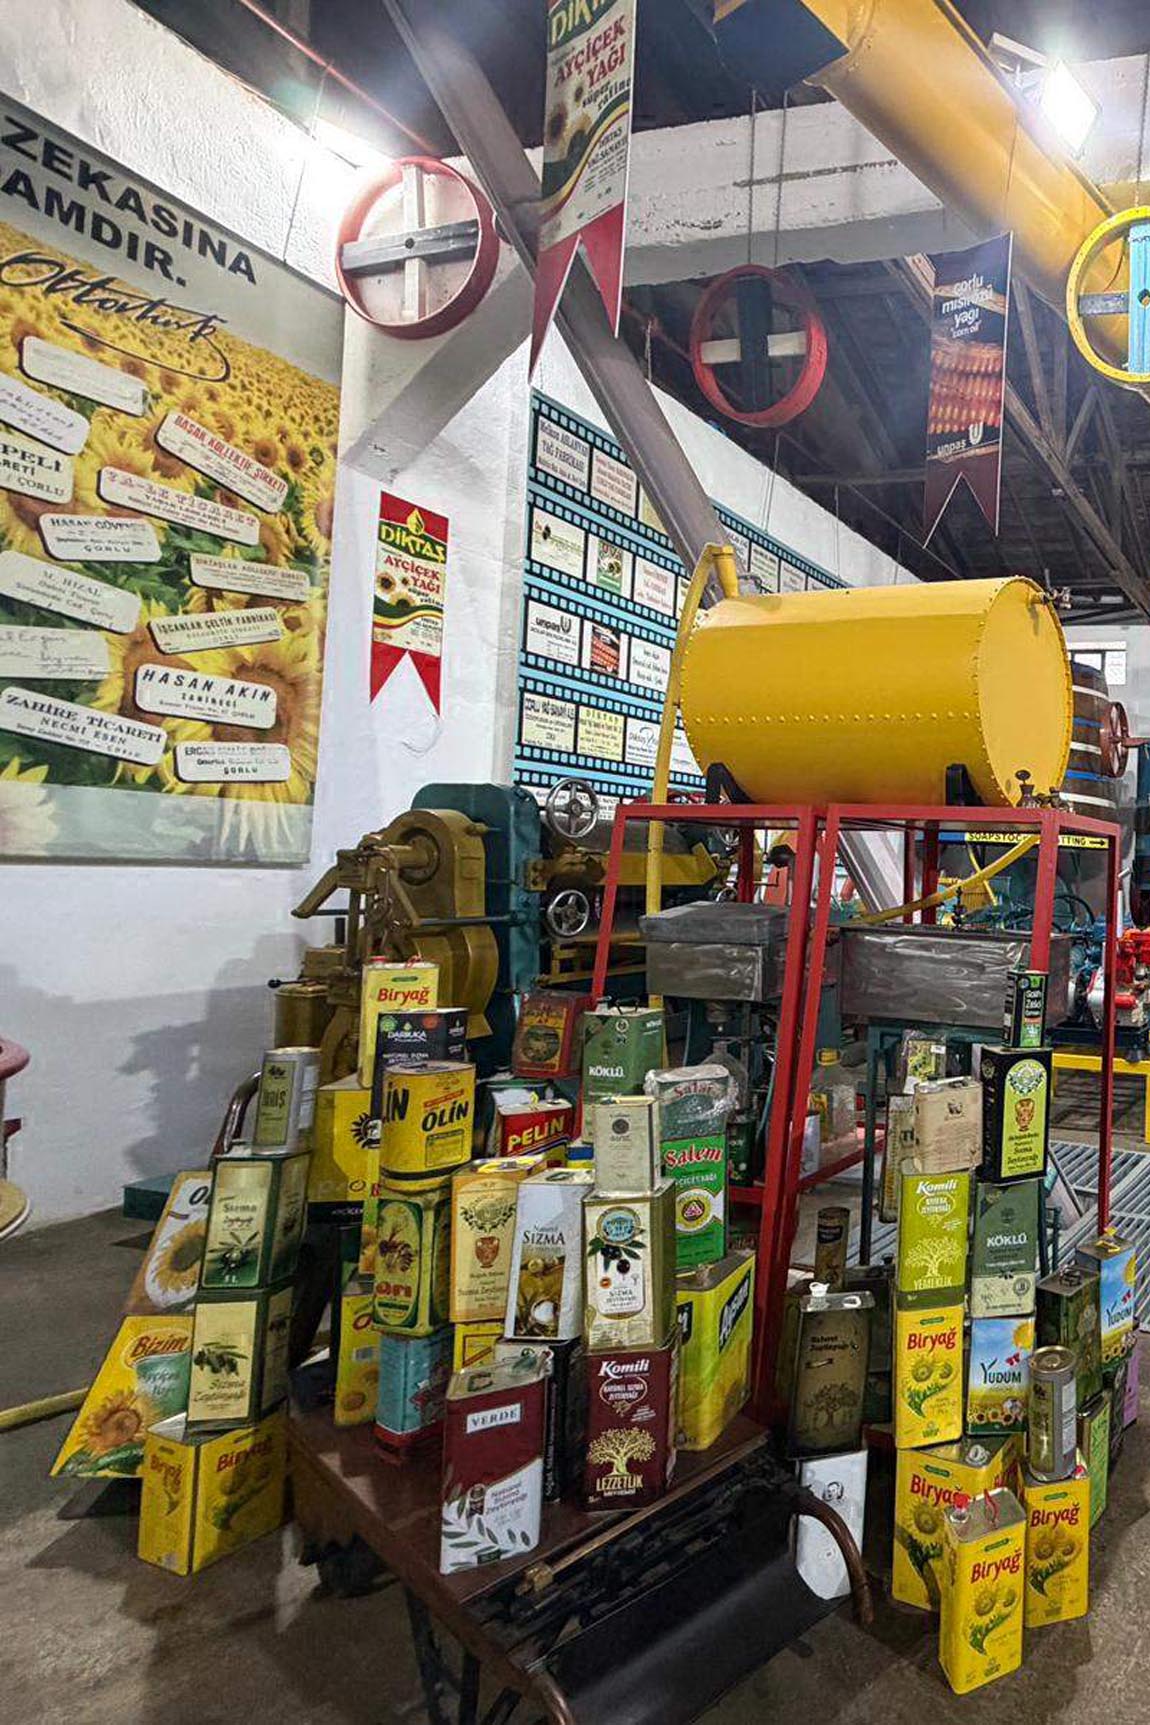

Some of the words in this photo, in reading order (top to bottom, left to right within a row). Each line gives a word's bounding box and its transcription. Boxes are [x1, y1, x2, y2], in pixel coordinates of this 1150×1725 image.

[1, 115, 257, 285] ZEKASINA
[383, 554, 441, 582] AYÇİÇEK
[410, 574, 441, 595] YAĞI
[142, 669, 214, 691] HASAN
[225, 683, 272, 702] AKIN
[377, 986, 431, 1006] Biryağ
[422, 1099, 470, 1132] OLİN
[507, 1116, 565, 1153] PELİN
[664, 1143, 724, 1168] Salem
[915, 1178, 958, 1196] Komili
[522, 1230, 566, 1245] SIZMA
[907, 1326, 958, 1357] Biryağ
[597, 1357, 650, 1379] Komili
[470, 1408, 518, 1428] VERDE
[1030, 1502, 1081, 1529] Biryağ
[970, 1548, 1023, 1585] Biryağ
